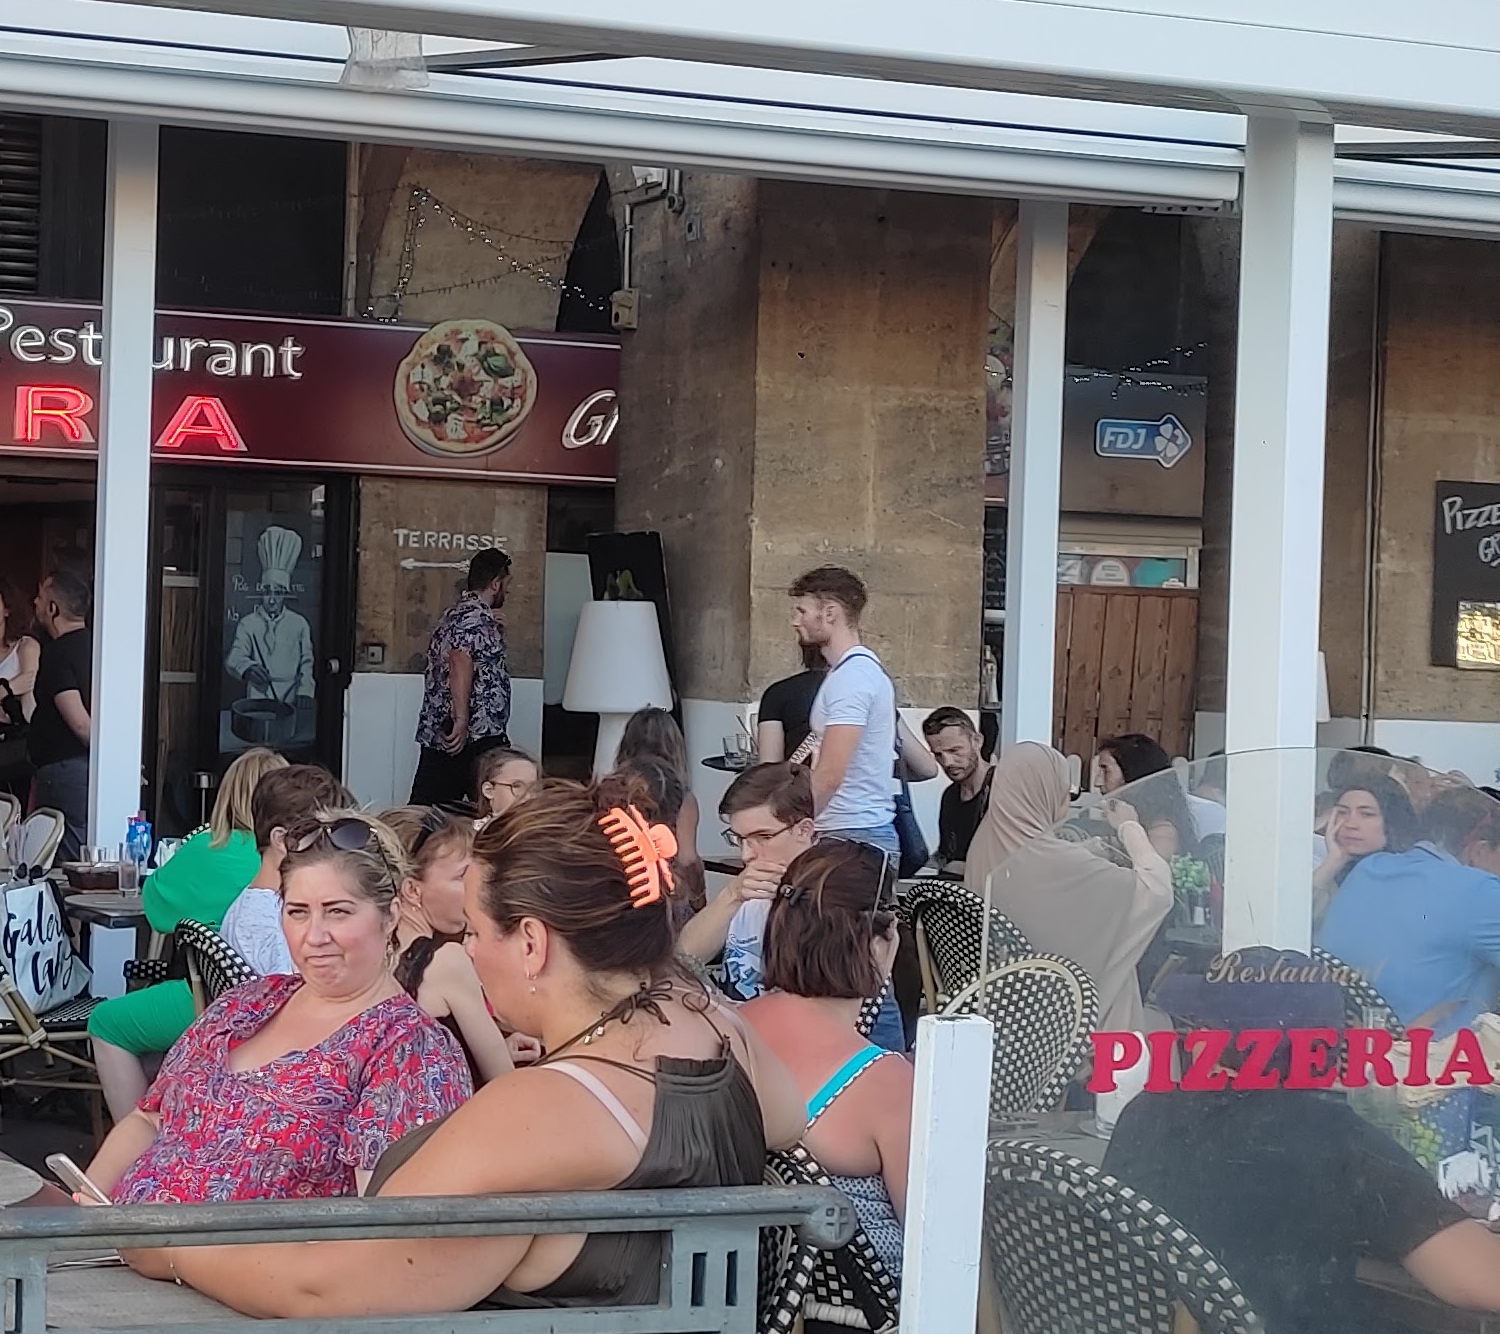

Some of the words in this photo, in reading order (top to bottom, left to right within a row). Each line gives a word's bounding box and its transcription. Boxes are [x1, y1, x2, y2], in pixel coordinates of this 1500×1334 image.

[1102, 427, 1147, 450] FDJ
[393, 528, 508, 553] TERRASSE
[1086, 1028, 1496, 1093] PIZZERIA
